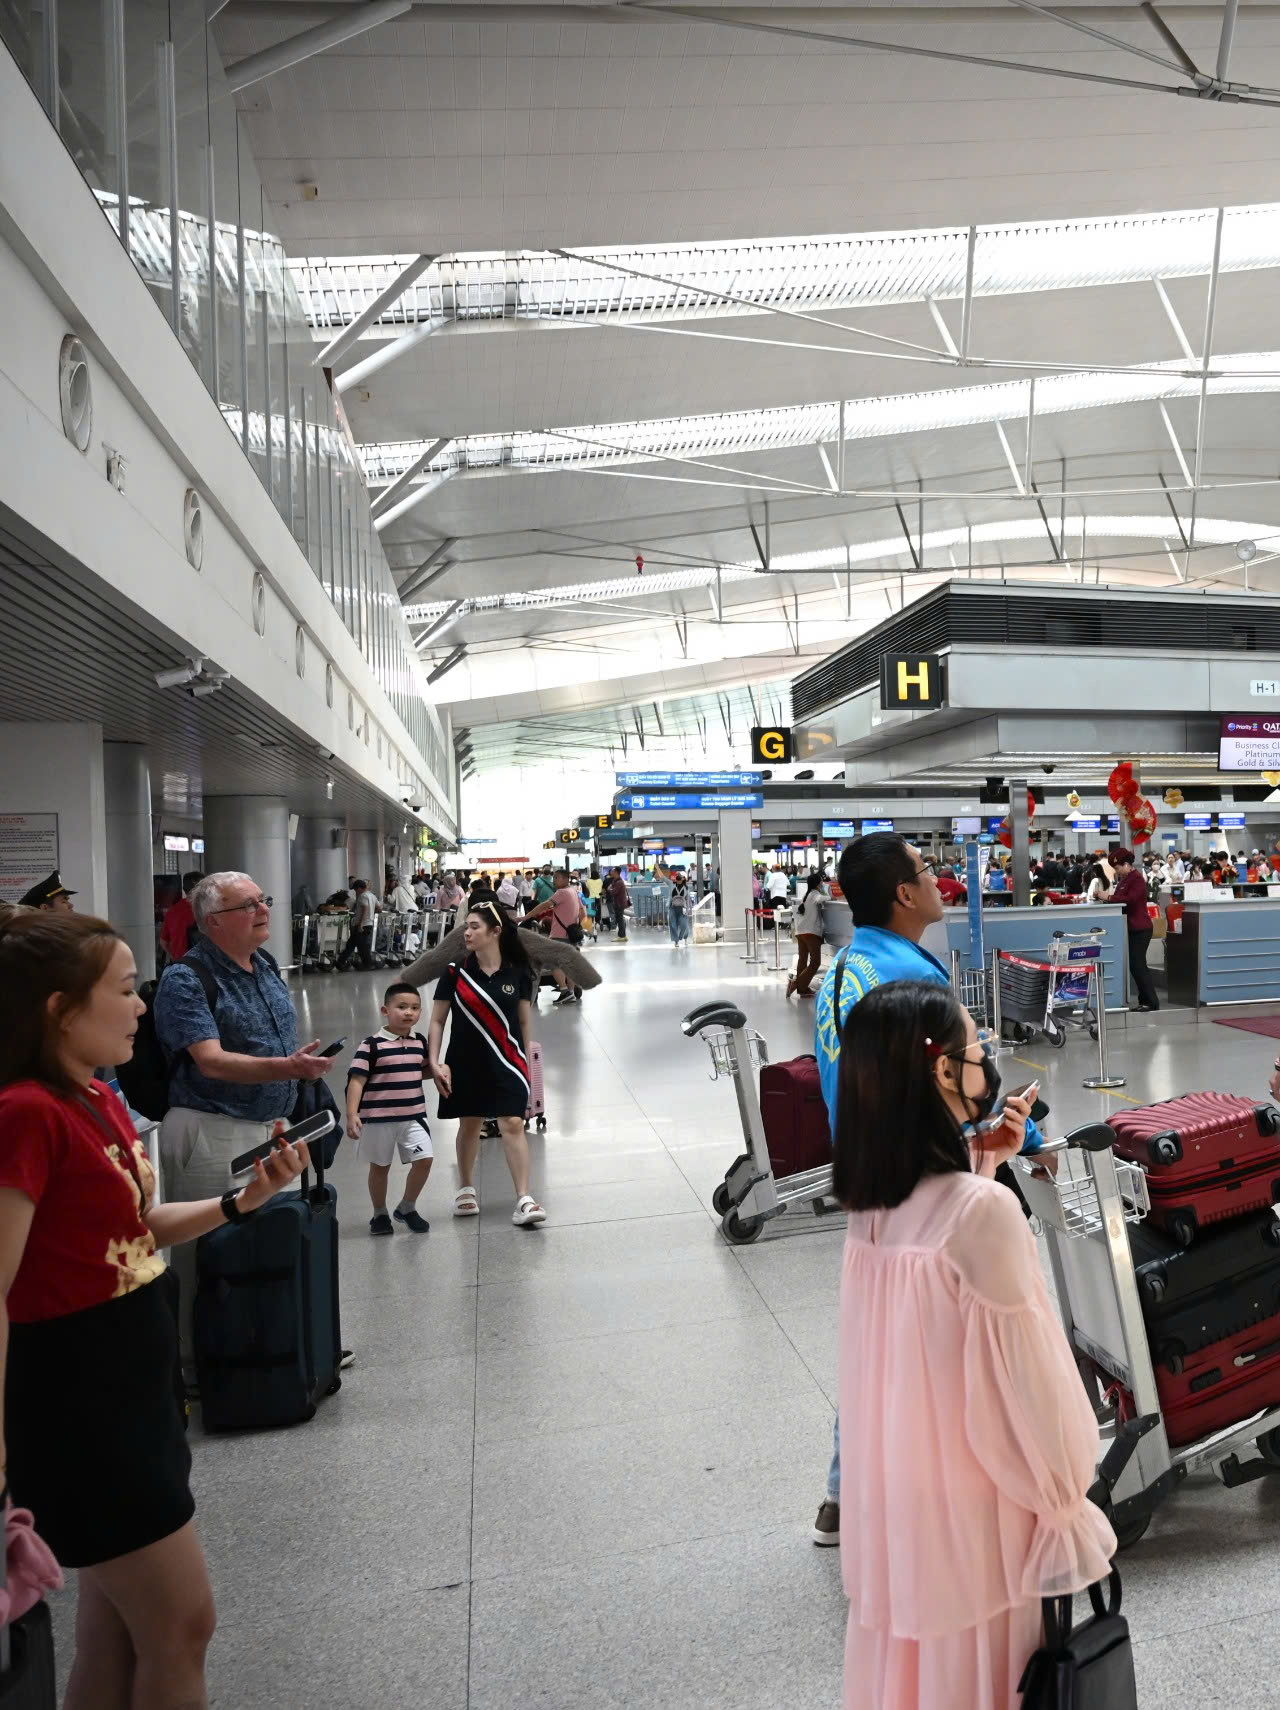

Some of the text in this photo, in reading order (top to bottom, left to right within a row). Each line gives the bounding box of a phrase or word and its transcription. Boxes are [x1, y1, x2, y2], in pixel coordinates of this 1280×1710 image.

[897, 661, 929, 700] H
[1255, 681, 1276, 694] H-1
[760, 731, 785, 759] G
[1237, 759, 1257, 767] Gold
[598, 816, 609, 828] E
[569, 829, 578, 839] D
